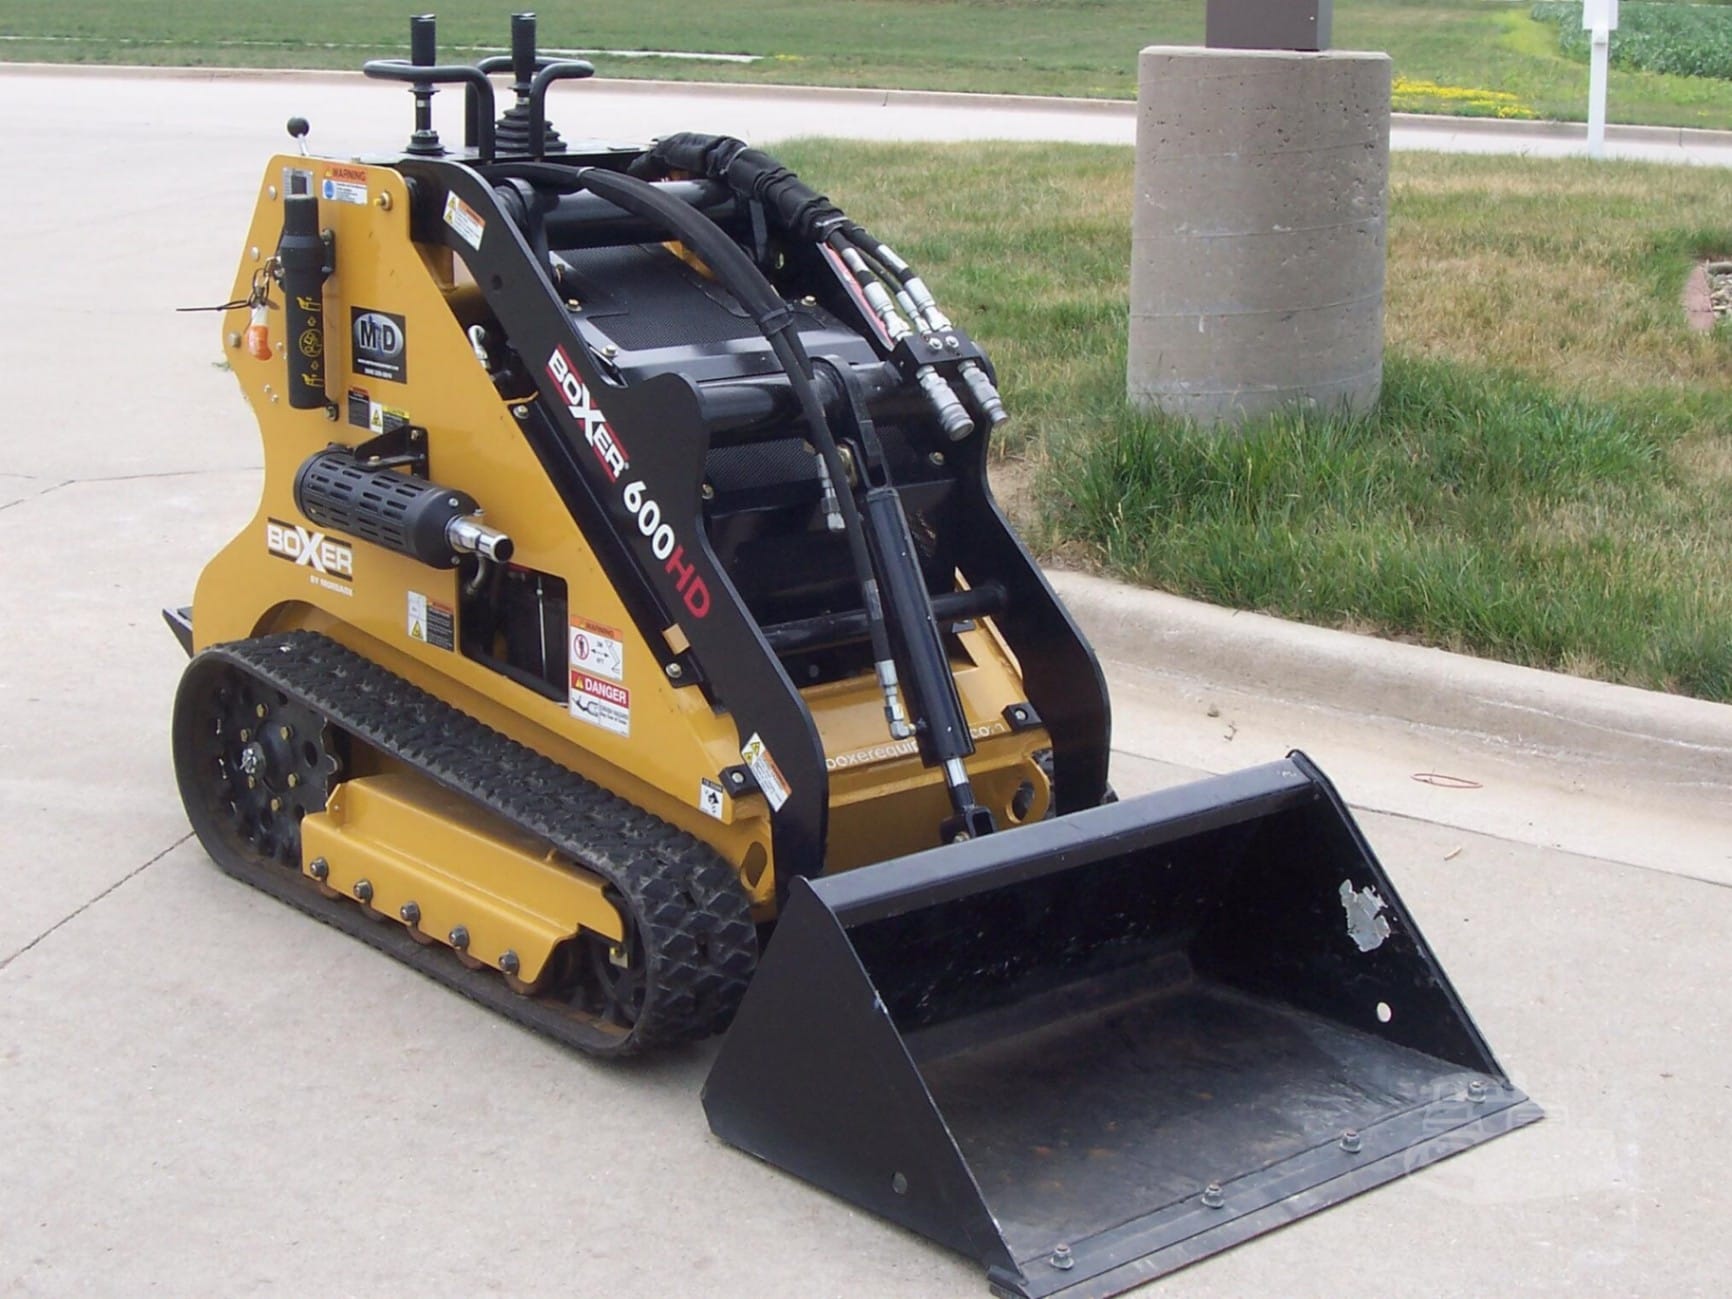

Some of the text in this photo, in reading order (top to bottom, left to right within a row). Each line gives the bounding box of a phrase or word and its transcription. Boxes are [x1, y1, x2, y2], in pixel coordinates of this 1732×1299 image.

[267, 524, 353, 574] BOXER
[624, 481, 711, 618] 600HD
[584, 678, 627, 704] DANGER
